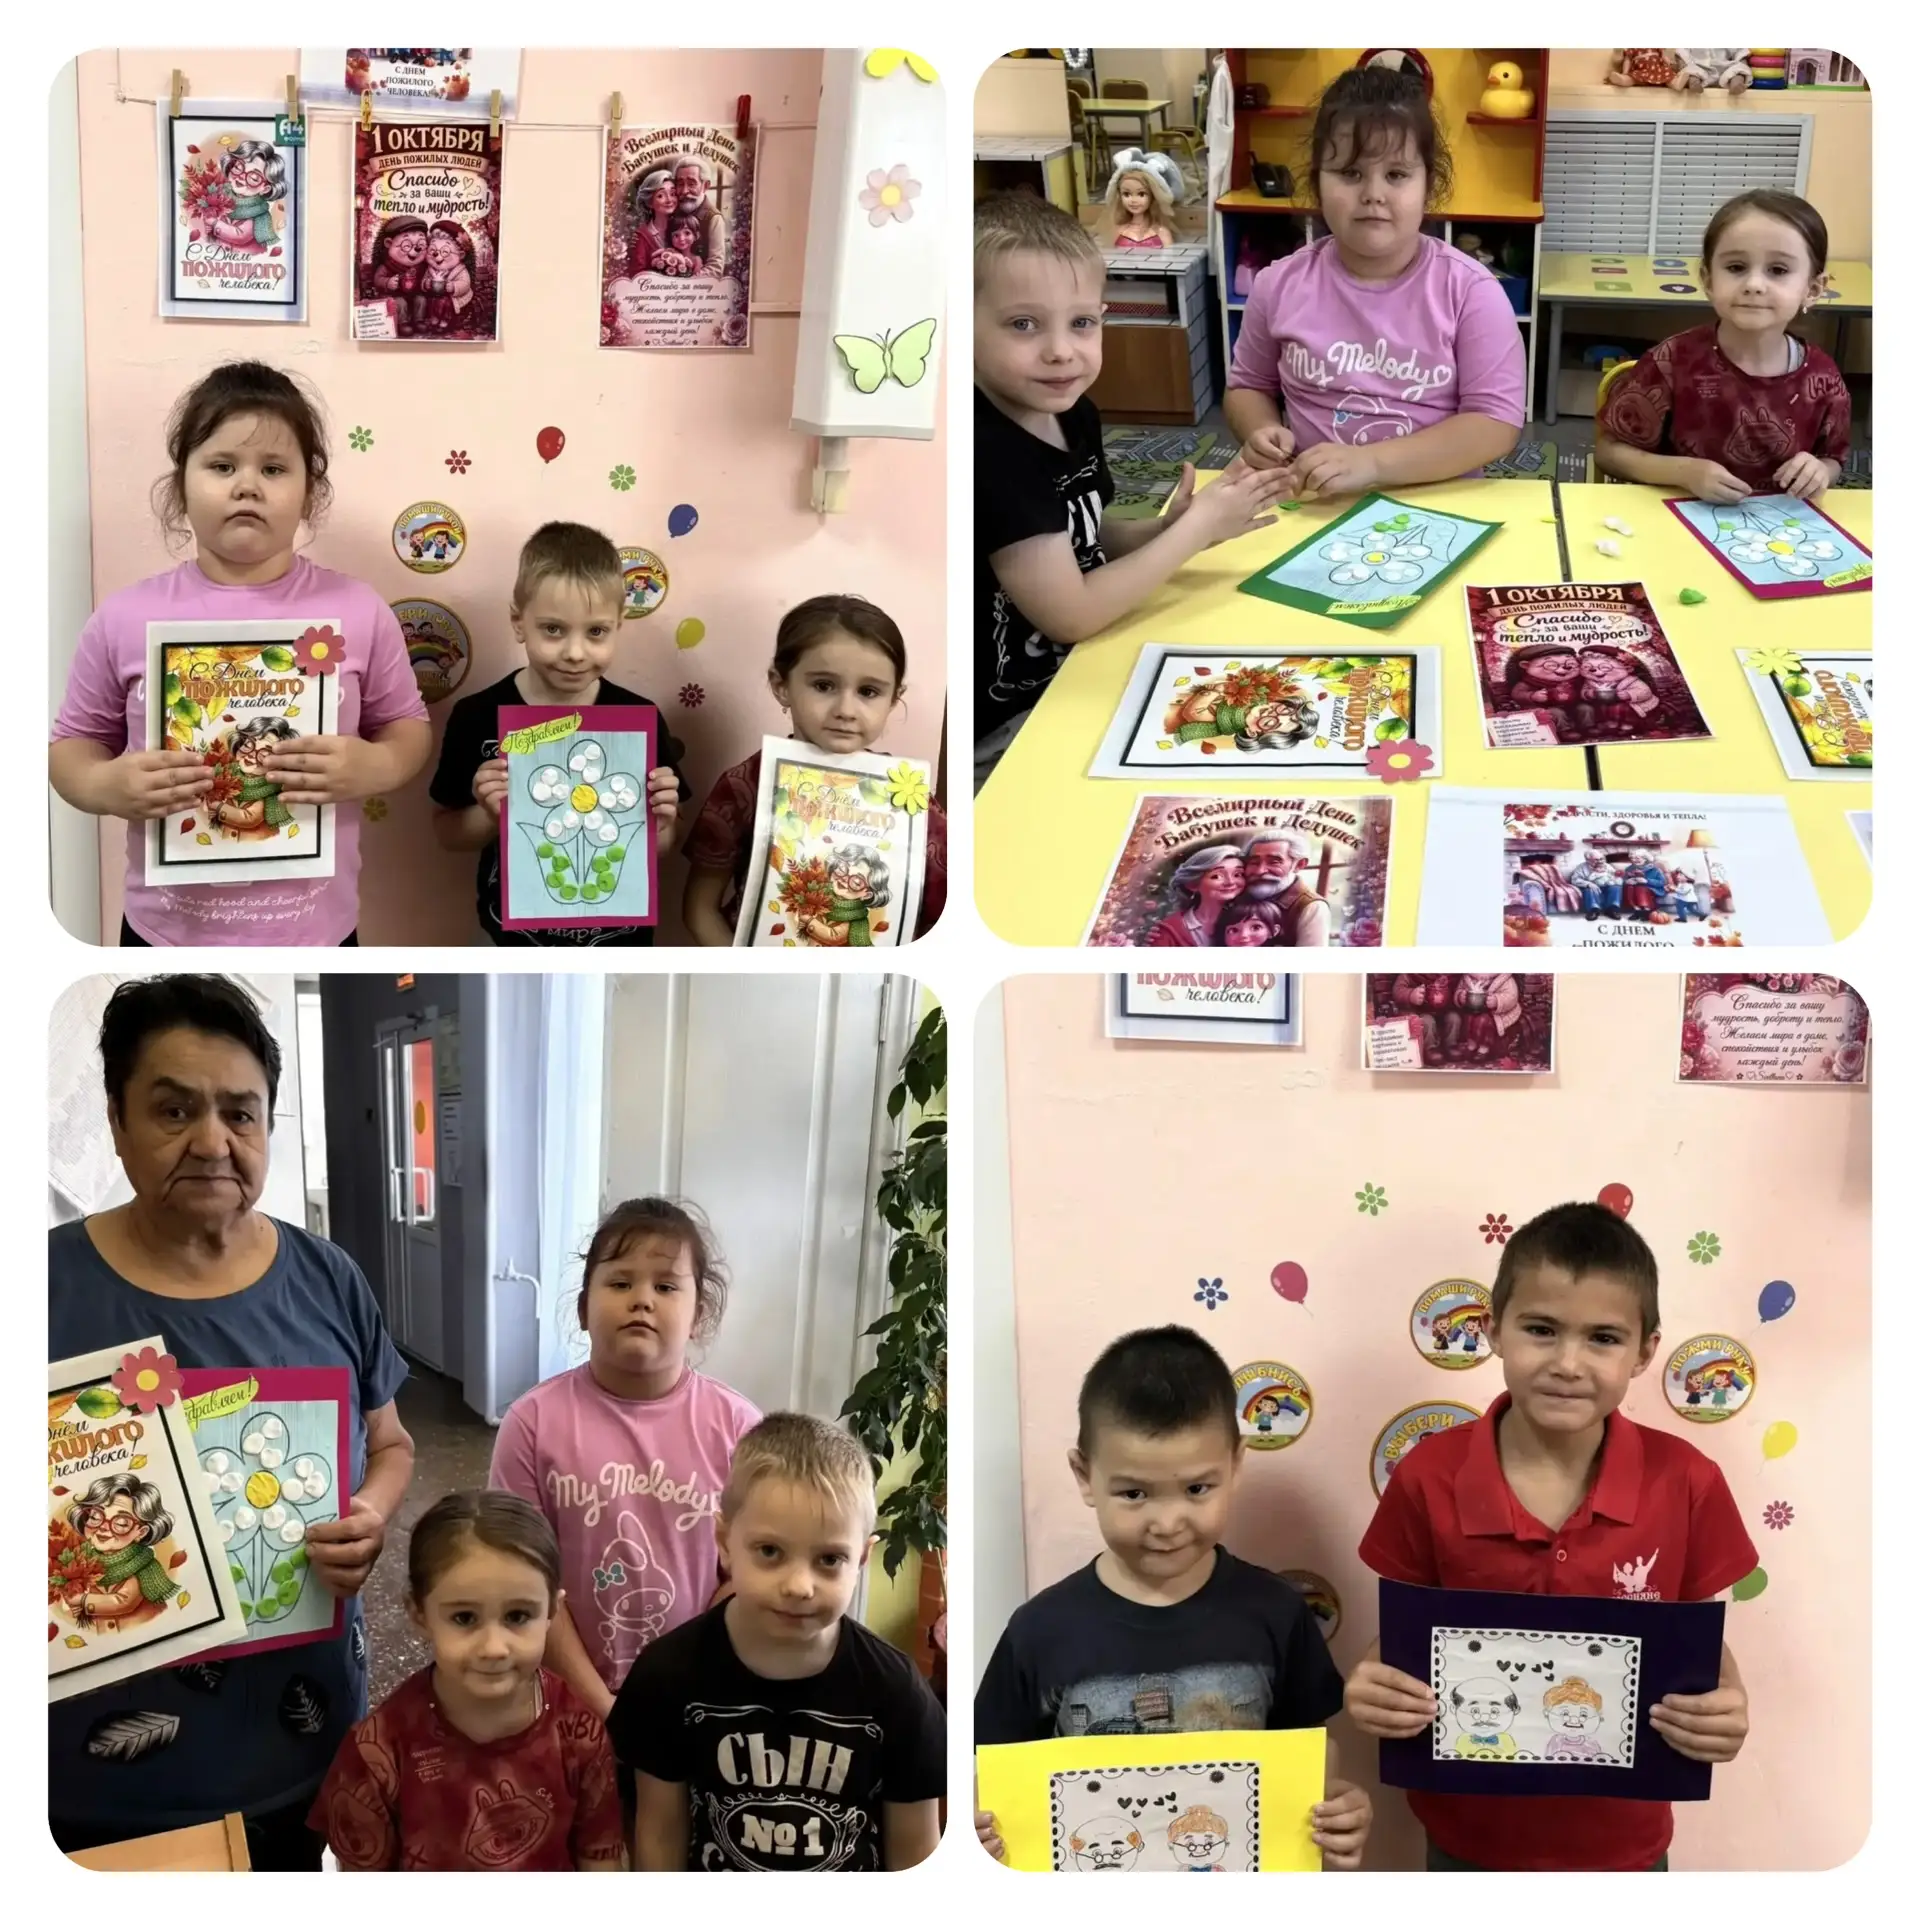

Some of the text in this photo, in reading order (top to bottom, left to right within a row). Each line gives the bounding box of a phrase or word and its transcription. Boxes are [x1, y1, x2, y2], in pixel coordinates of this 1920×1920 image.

[395, 65, 426, 75] С ДНЕМ
[386, 76, 434, 87] ПОЖИЛОГО
[372, 125, 485, 153] 1 ОКТЯБРЯ
[624, 126, 736, 154] Всемирный День
[378, 154, 482, 169] ДЕНЬ ПОЖИЛЫХ ЛЮДЕЙ
[621, 141, 741, 174] Бабушек и Дедушек
[387, 168, 460, 190] Спасибо
[410, 189, 451, 198] за ваши
[373, 192, 490, 219] тепло и мудрость!
[185, 243, 203, 261] С
[1286, 338, 1434, 402] My Melody
[1487, 585, 1625, 606] 1 ОКТЯБРЯ
[1500, 602, 1627, 615] ДЕНЬ ПОЖИЛЫХ ЛЮДЕЙ
[1513, 610, 1603, 628] Спасибо
[1500, 632, 1555, 643] тепло
[1569, 626, 1648, 644] мудрость!
[189, 662, 209, 681] С
[229, 690, 298, 708] человека!
[502, 709, 577, 754] Поздравляем!
[1167, 798, 1357, 826] Всемирный День
[1155, 813, 1365, 851] Бабушек и Дедушек
[1597, 924, 1656, 936] С ДНЕМ
[1185, 979, 1267, 1004] человека!
[1731, 994, 1782, 1011] Спасибо
[1799, 1002, 1825, 1013] вашу
[1762, 1011, 1804, 1027] доброту
[1720, 1026, 1767, 1039] Желаем
[1769, 1032, 1794, 1043] мира
[1721, 1043, 1779, 1053] спокойствия
[1791, 1042, 1823, 1056] улыбок
[1736, 1055, 1807, 1070] каждый день!
[1418, 1284, 1469, 1313] ПОМАШИ
[1671, 1340, 1750, 1375] ПОЖМИ РУКУ
[1234, 1366, 1302, 1397] ЛЫБНИСЬ
[1384, 1412, 1456, 1459] ВЫБЕРИ
[54, 1436, 138, 1478] человека!
[546, 1458, 709, 1532] My Melody
[717, 1732, 854, 1795] СЫН
